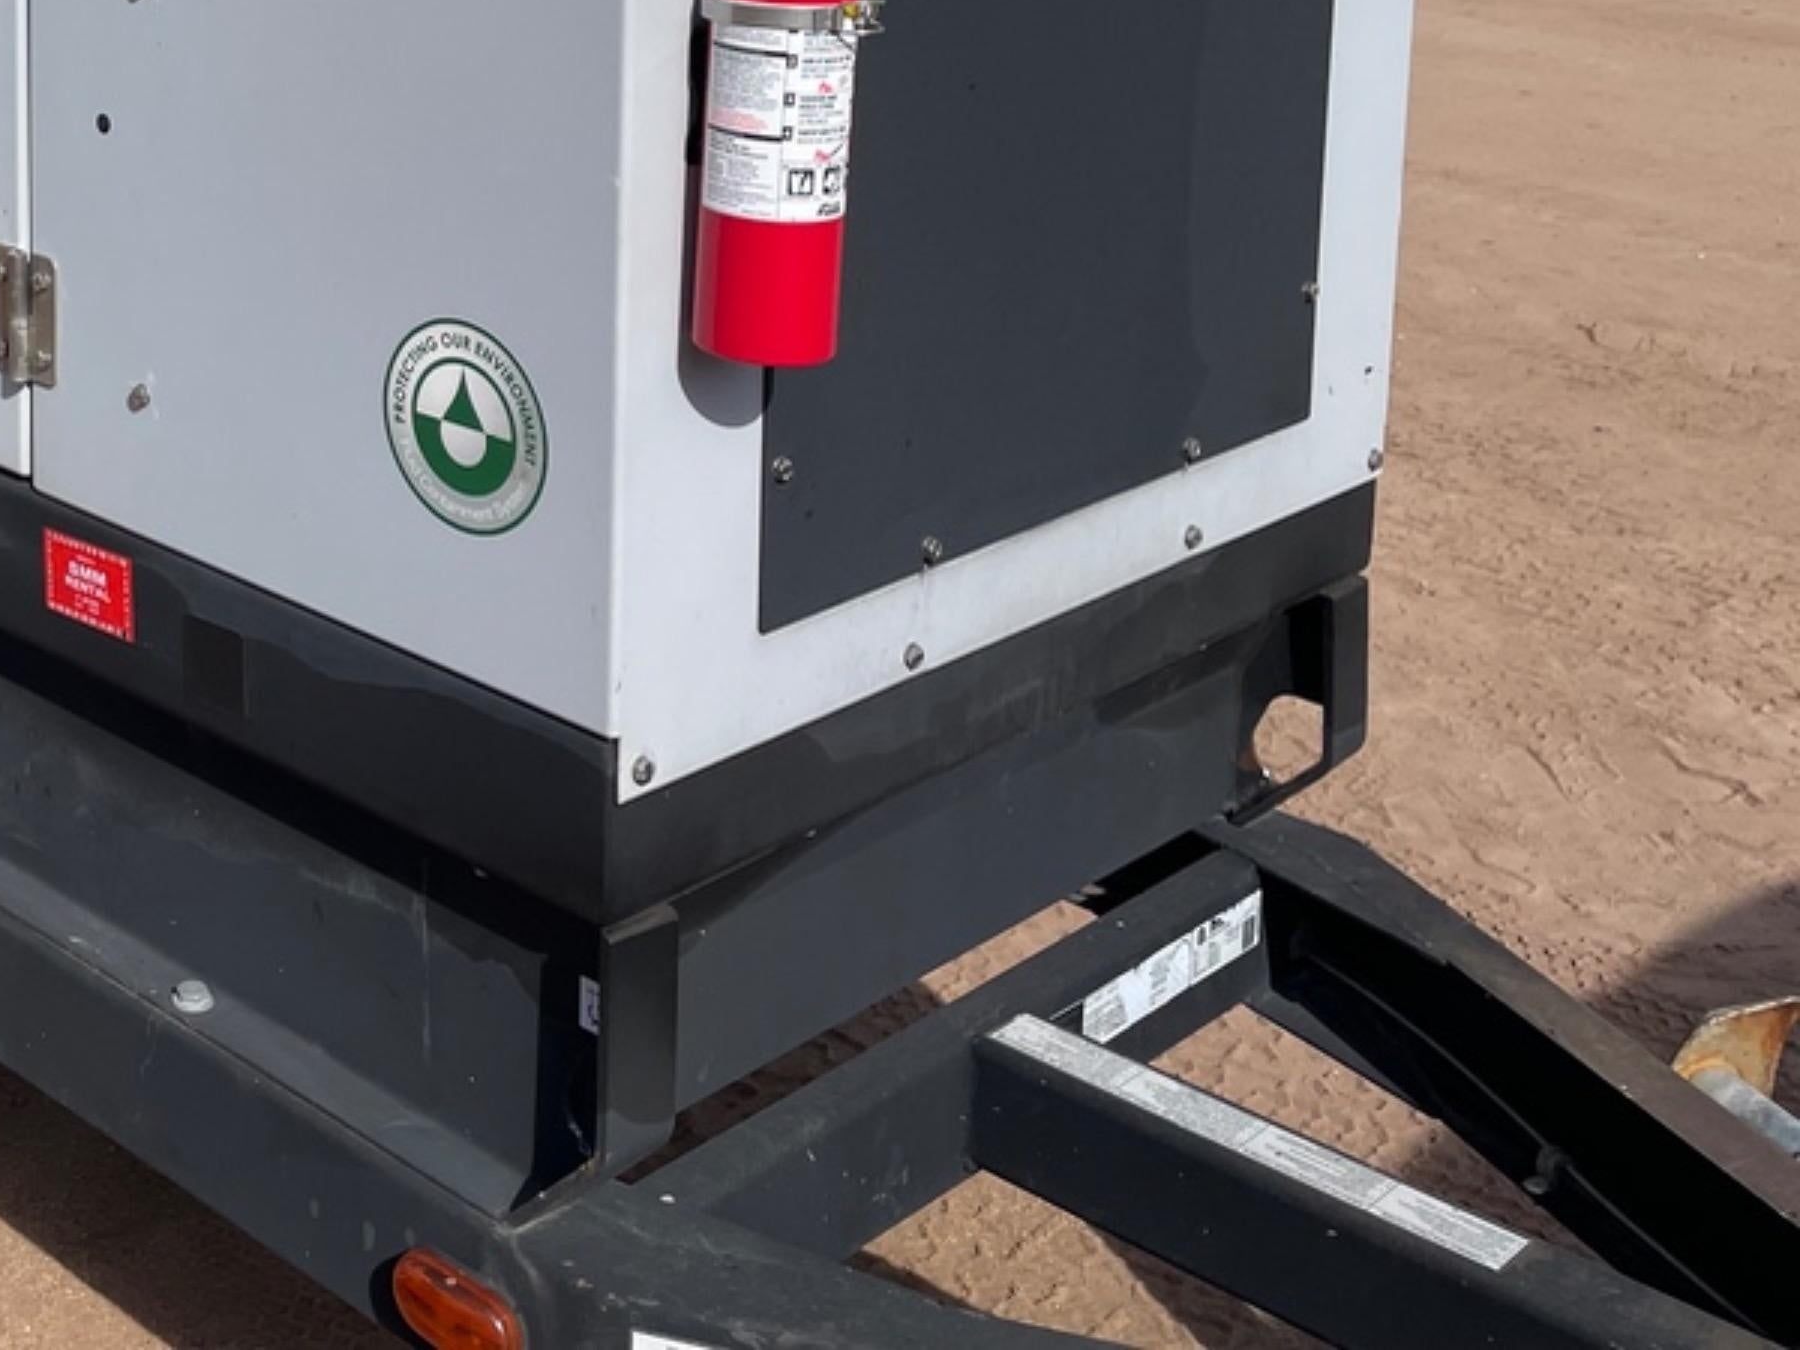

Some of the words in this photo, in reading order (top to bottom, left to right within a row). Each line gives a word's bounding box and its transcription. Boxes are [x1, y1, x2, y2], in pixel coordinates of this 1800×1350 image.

[391, 334, 439, 425] PROTECTING
[440, 331, 472, 352] OUR
[473, 342, 538, 466] ENVIRONMENT
